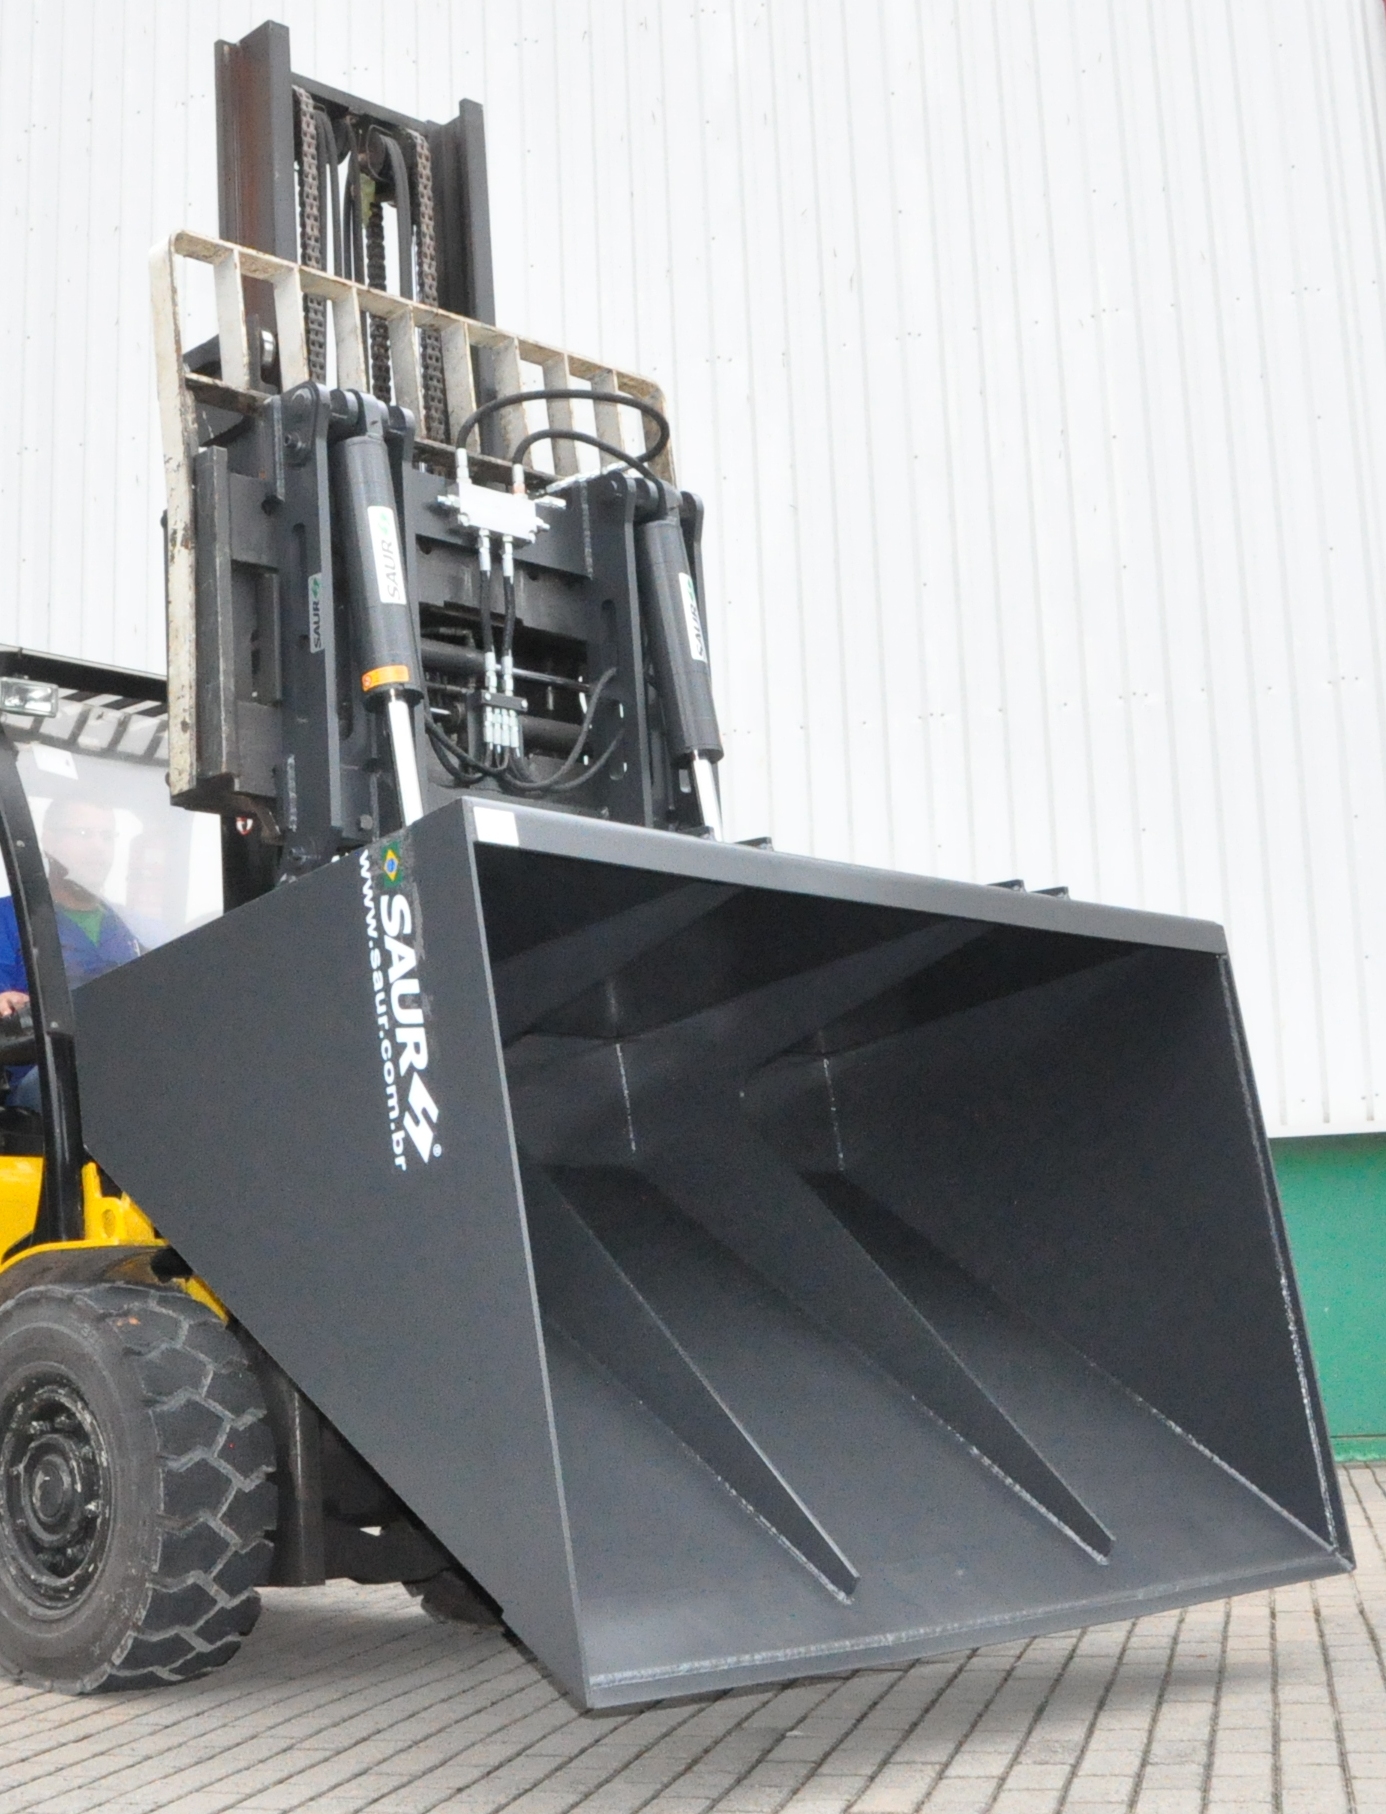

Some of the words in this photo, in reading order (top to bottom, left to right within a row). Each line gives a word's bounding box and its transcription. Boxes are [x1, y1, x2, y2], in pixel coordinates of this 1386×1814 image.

[313, 601, 321, 648] SAUR
[381, 539, 401, 600] SAUR
[359, 849, 407, 1171] www.saur.com.br
[380, 894, 428, 1077] SAUR
